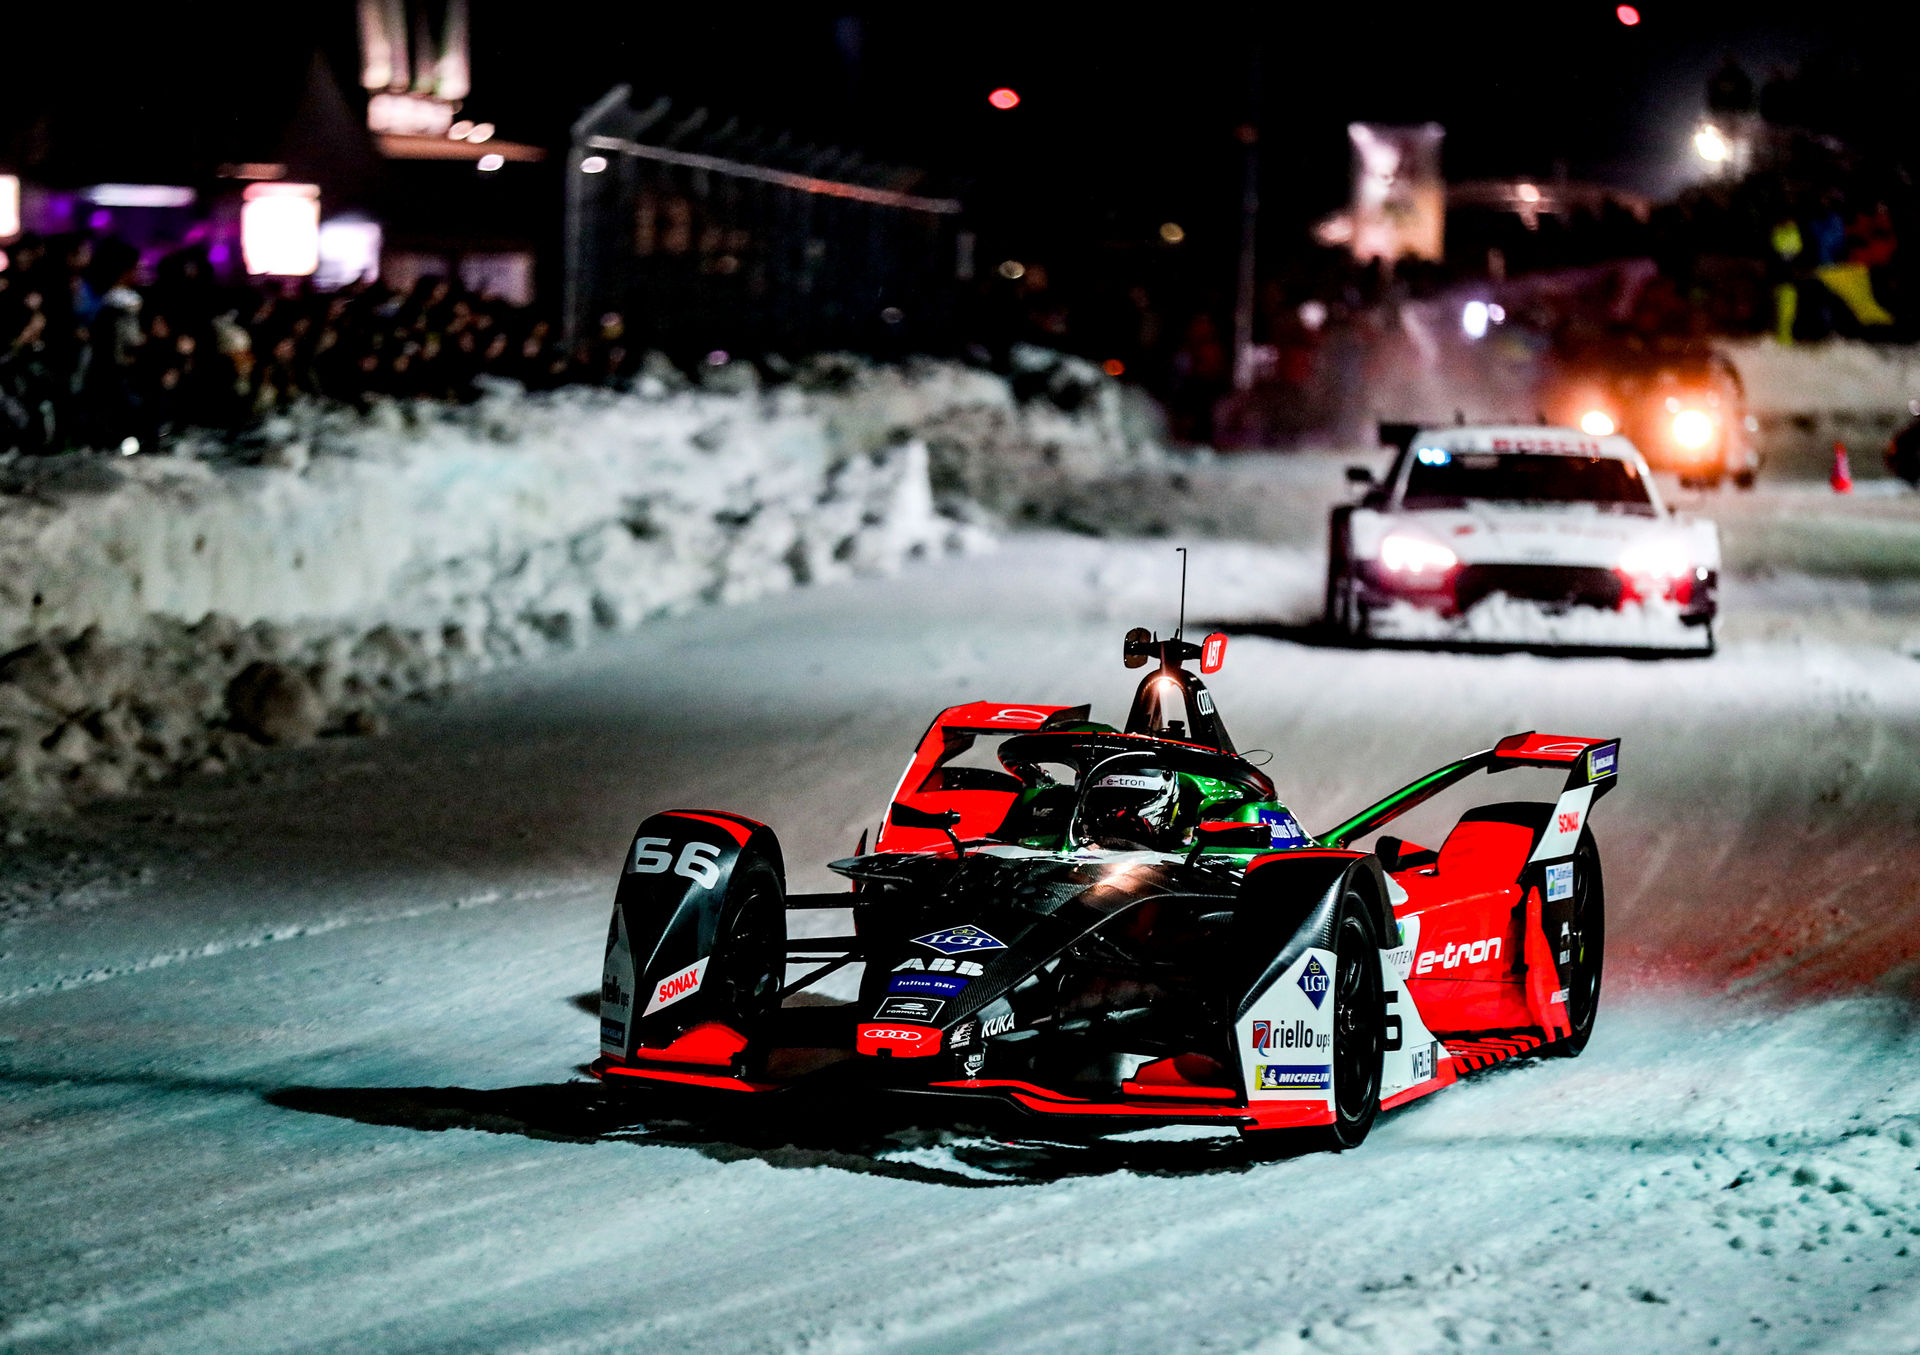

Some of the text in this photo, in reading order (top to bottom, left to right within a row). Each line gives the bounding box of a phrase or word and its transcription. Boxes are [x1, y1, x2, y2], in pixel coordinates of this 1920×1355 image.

[1107, 778, 1146, 787] e-tron
[1558, 810, 1580, 834] SONAX
[626, 836, 722, 890] 66
[928, 934, 993, 947] LGT
[891, 958, 984, 977] ABB
[1415, 937, 1502, 974] e-tron
[658, 968, 699, 1003] SONAX
[1303, 975, 1328, 992] LGT
[981, 1012, 1016, 1039] KUKA
[1273, 1020, 1314, 1049] riello
[1279, 1072, 1330, 1083] MICHELIN
